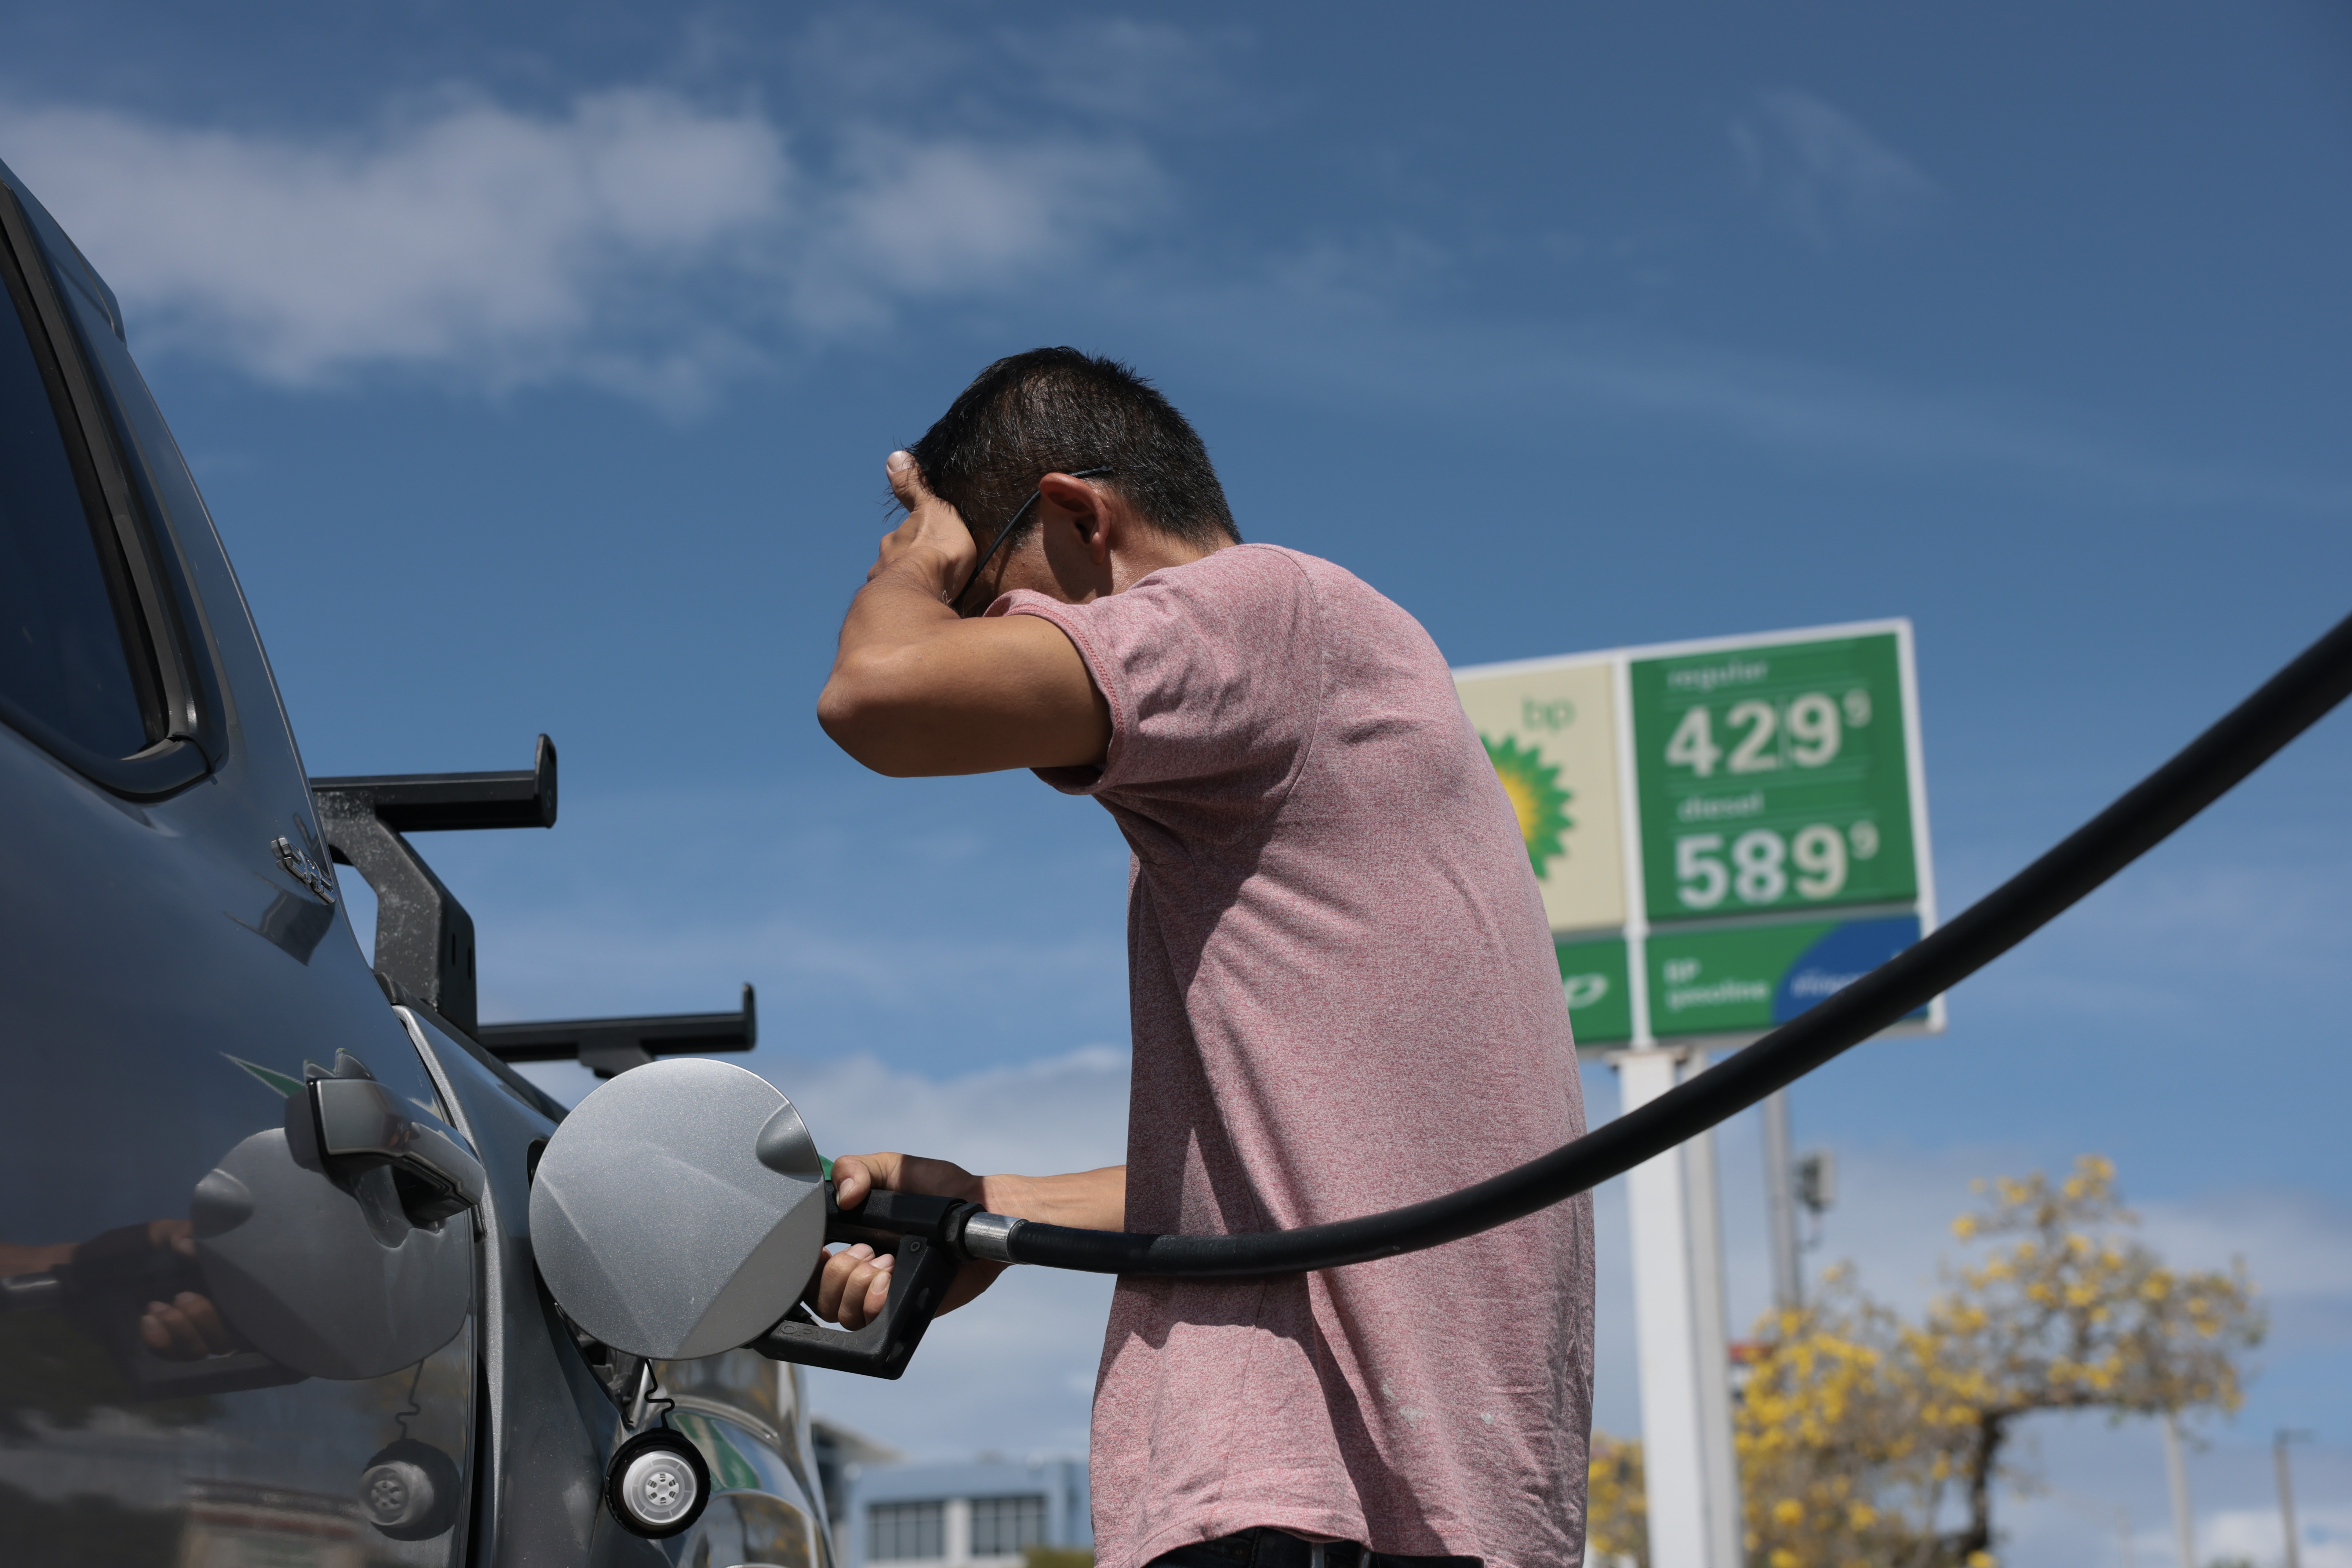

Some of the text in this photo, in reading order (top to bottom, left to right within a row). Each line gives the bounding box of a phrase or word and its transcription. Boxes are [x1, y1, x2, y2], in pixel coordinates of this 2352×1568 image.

[1522, 696, 1577, 737] bp
[1679, 790, 1762, 821] diesel
[781, 1325, 838, 1342] OPW
